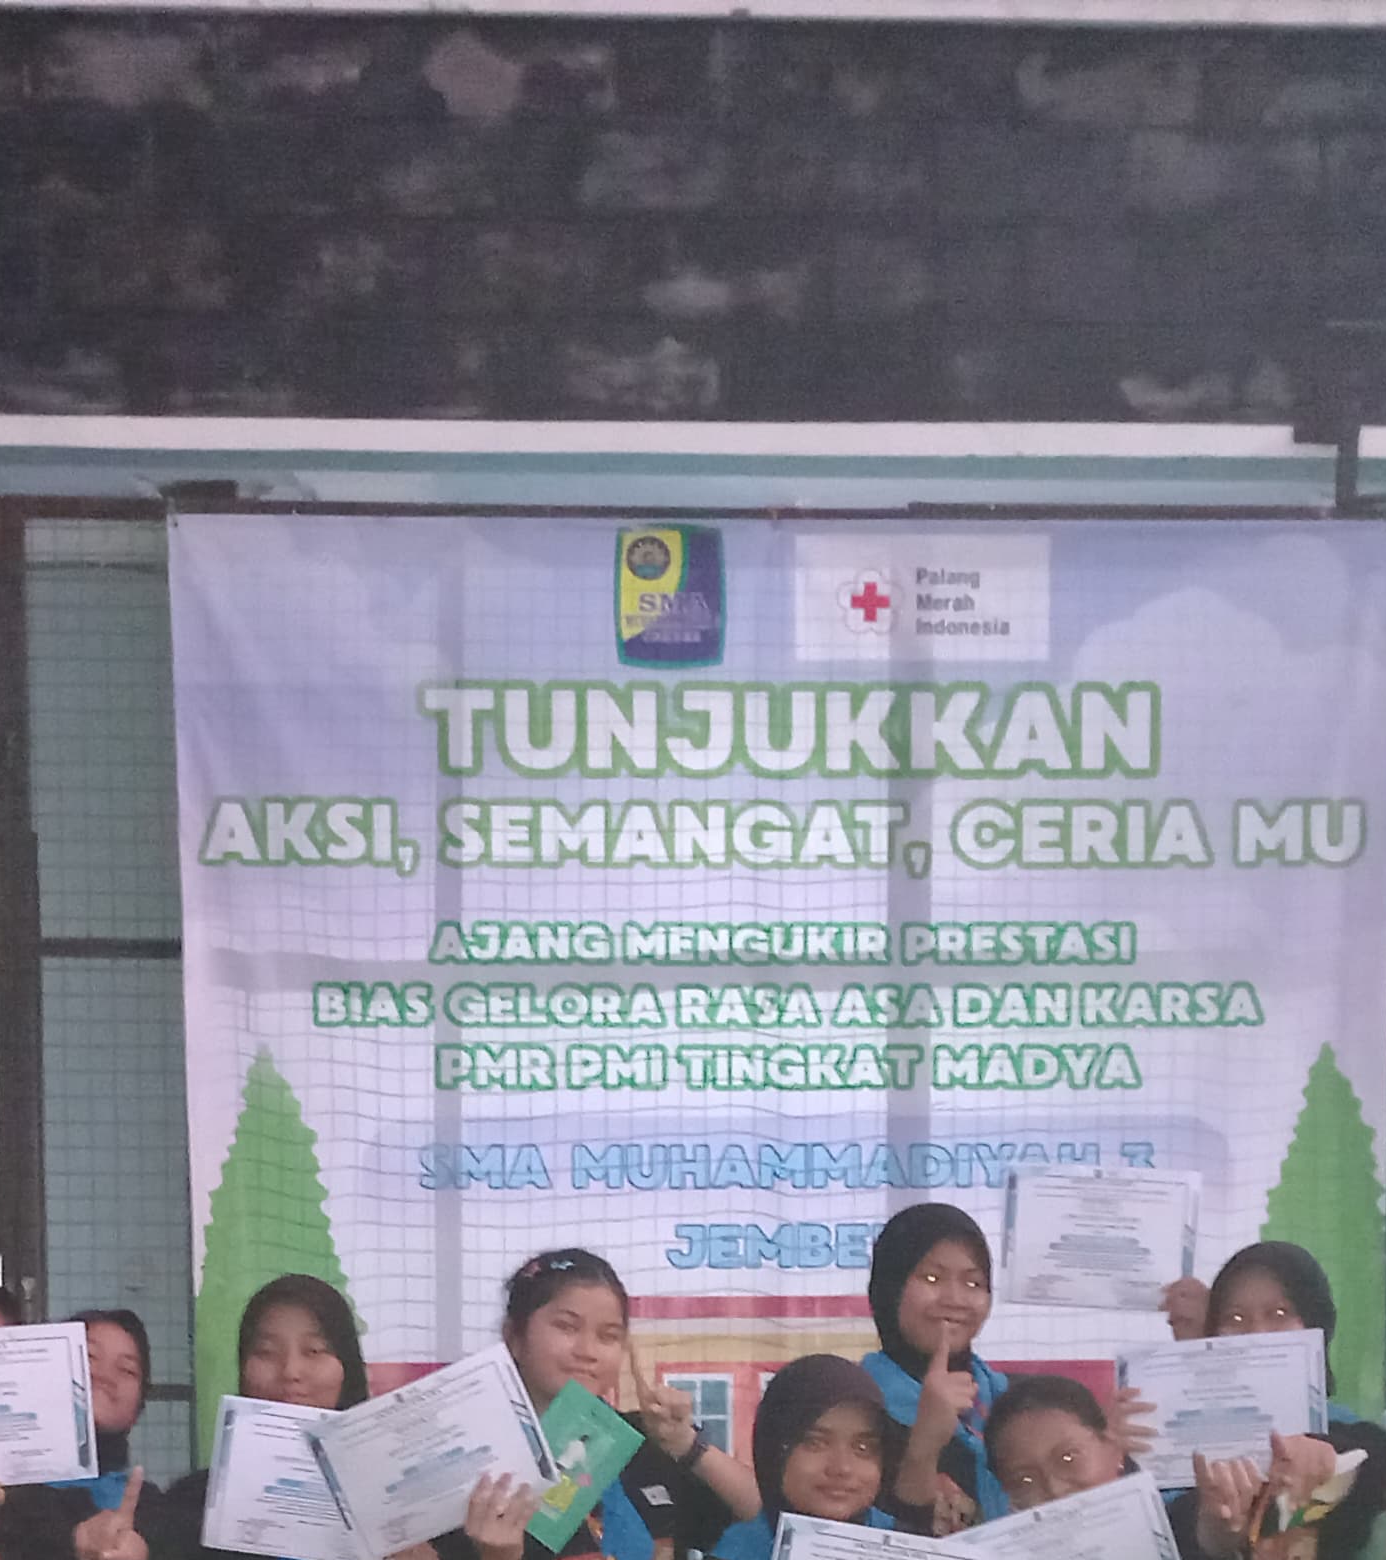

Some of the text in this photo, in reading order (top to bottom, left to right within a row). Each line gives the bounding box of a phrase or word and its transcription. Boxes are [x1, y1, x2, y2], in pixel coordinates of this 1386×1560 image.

[916, 567, 980, 589] Palang
[916, 593, 975, 611] Merah
[916, 618, 1010, 635] Indonesia
[418, 682, 1159, 777] TUNJUKKAN
[201, 796, 1365, 877] AKSI, SEMANGAT, CERIA MU
[429, 921, 1136, 965] AJANG MENGUKIR PRESTASI
[313, 982, 1265, 1028] BIAS GELORA RASA ASA DAN KARSA
[435, 1043, 1143, 1089] PMR PMI TINGKAT MADYA
[419, 1143, 552, 1189] SMA
[667, 1223, 877, 1269] JEMBE
